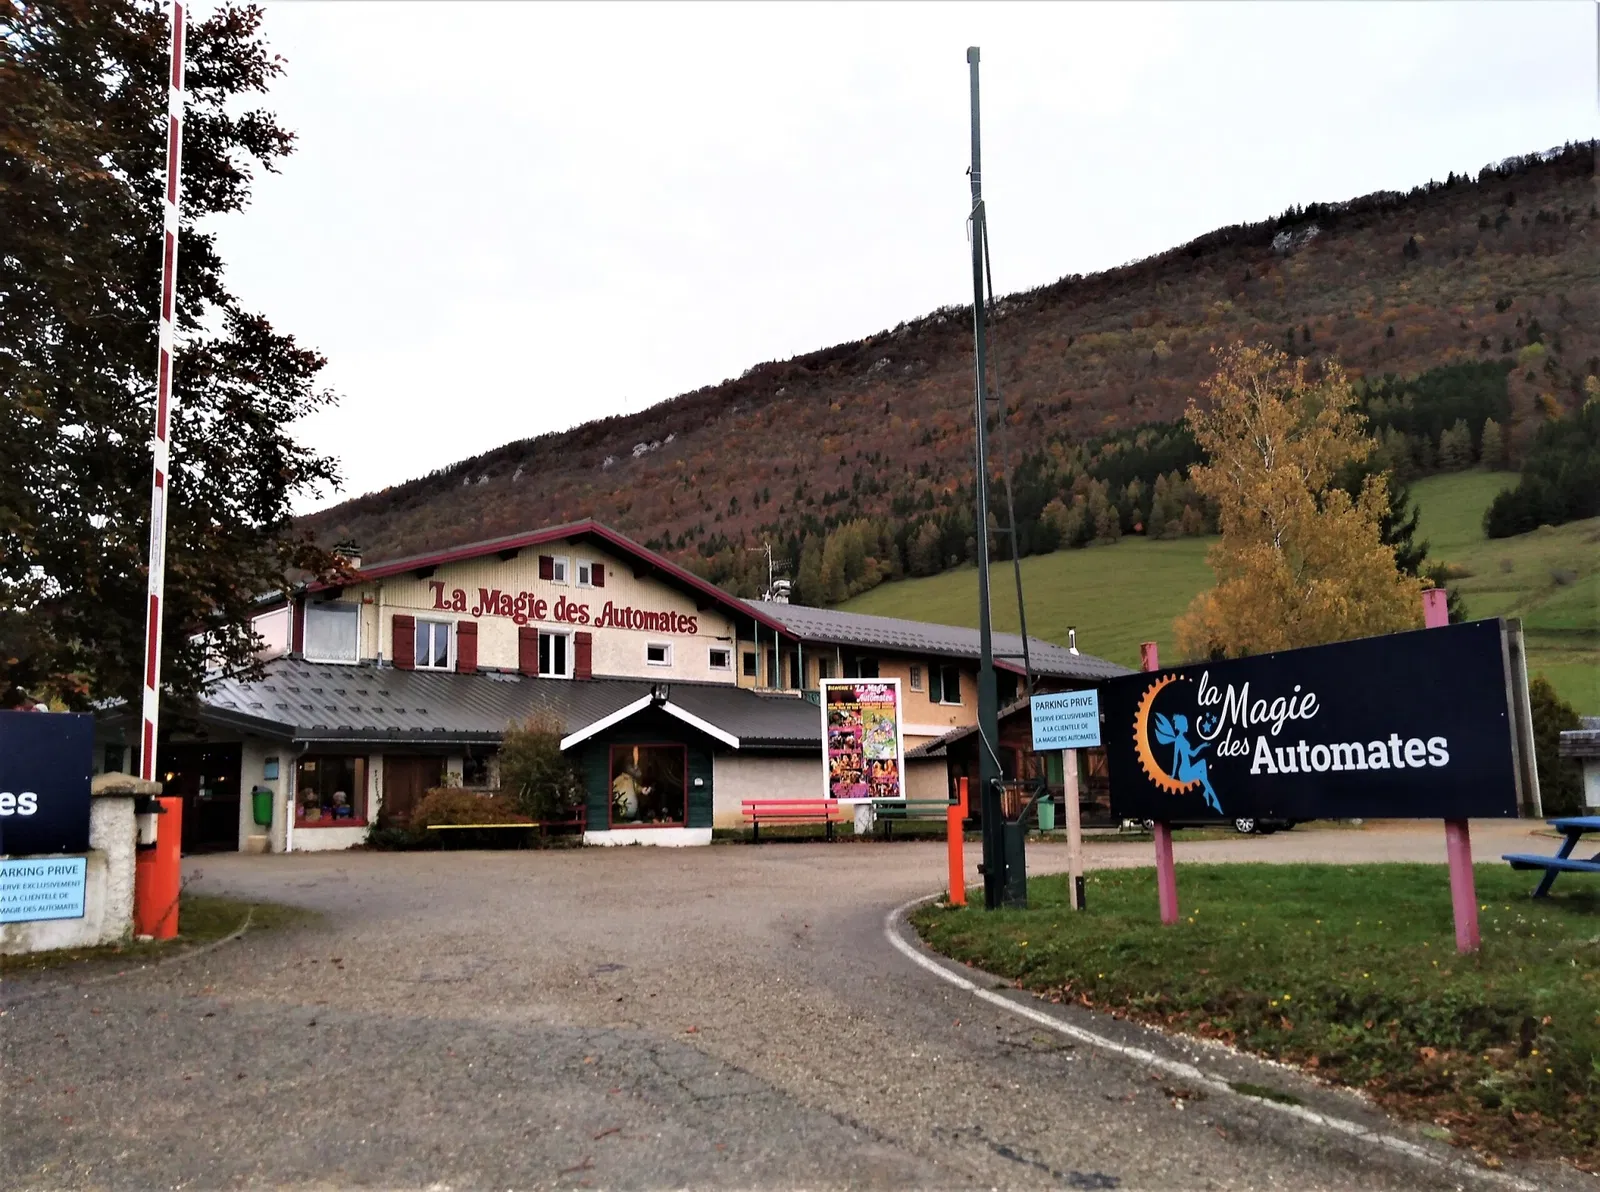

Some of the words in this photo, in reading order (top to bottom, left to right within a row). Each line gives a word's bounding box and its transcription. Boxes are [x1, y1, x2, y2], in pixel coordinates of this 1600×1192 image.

[429, 580, 467, 612] La
[471, 587, 548, 625] Magie
[553, 595, 590, 624] des
[594, 600, 699, 635] Automates
[1197, 670, 1223, 707] la
[1035, 699, 1069, 711] PARKING
[1070, 697, 1093, 707] PRIVE
[1055, 711, 1096, 720] EXCLUSIVEMENT
[1196, 681, 1320, 741] Magie
[1054, 723, 1080, 731] CLIENTELE
[1217, 727, 1250, 757] des
[1250, 733, 1450, 775] Automates
[0, 791, 38, 816] es
[0, 866, 44, 877] ARKING
[47, 864, 79, 875] PRIVE
[22, 880, 81, 890] EXCLUSIVEMENT
[19, 893, 57, 901] CLIENTELE
[23, 905, 37, 913] DES
[38, 903, 79, 911] AUTOMATES
